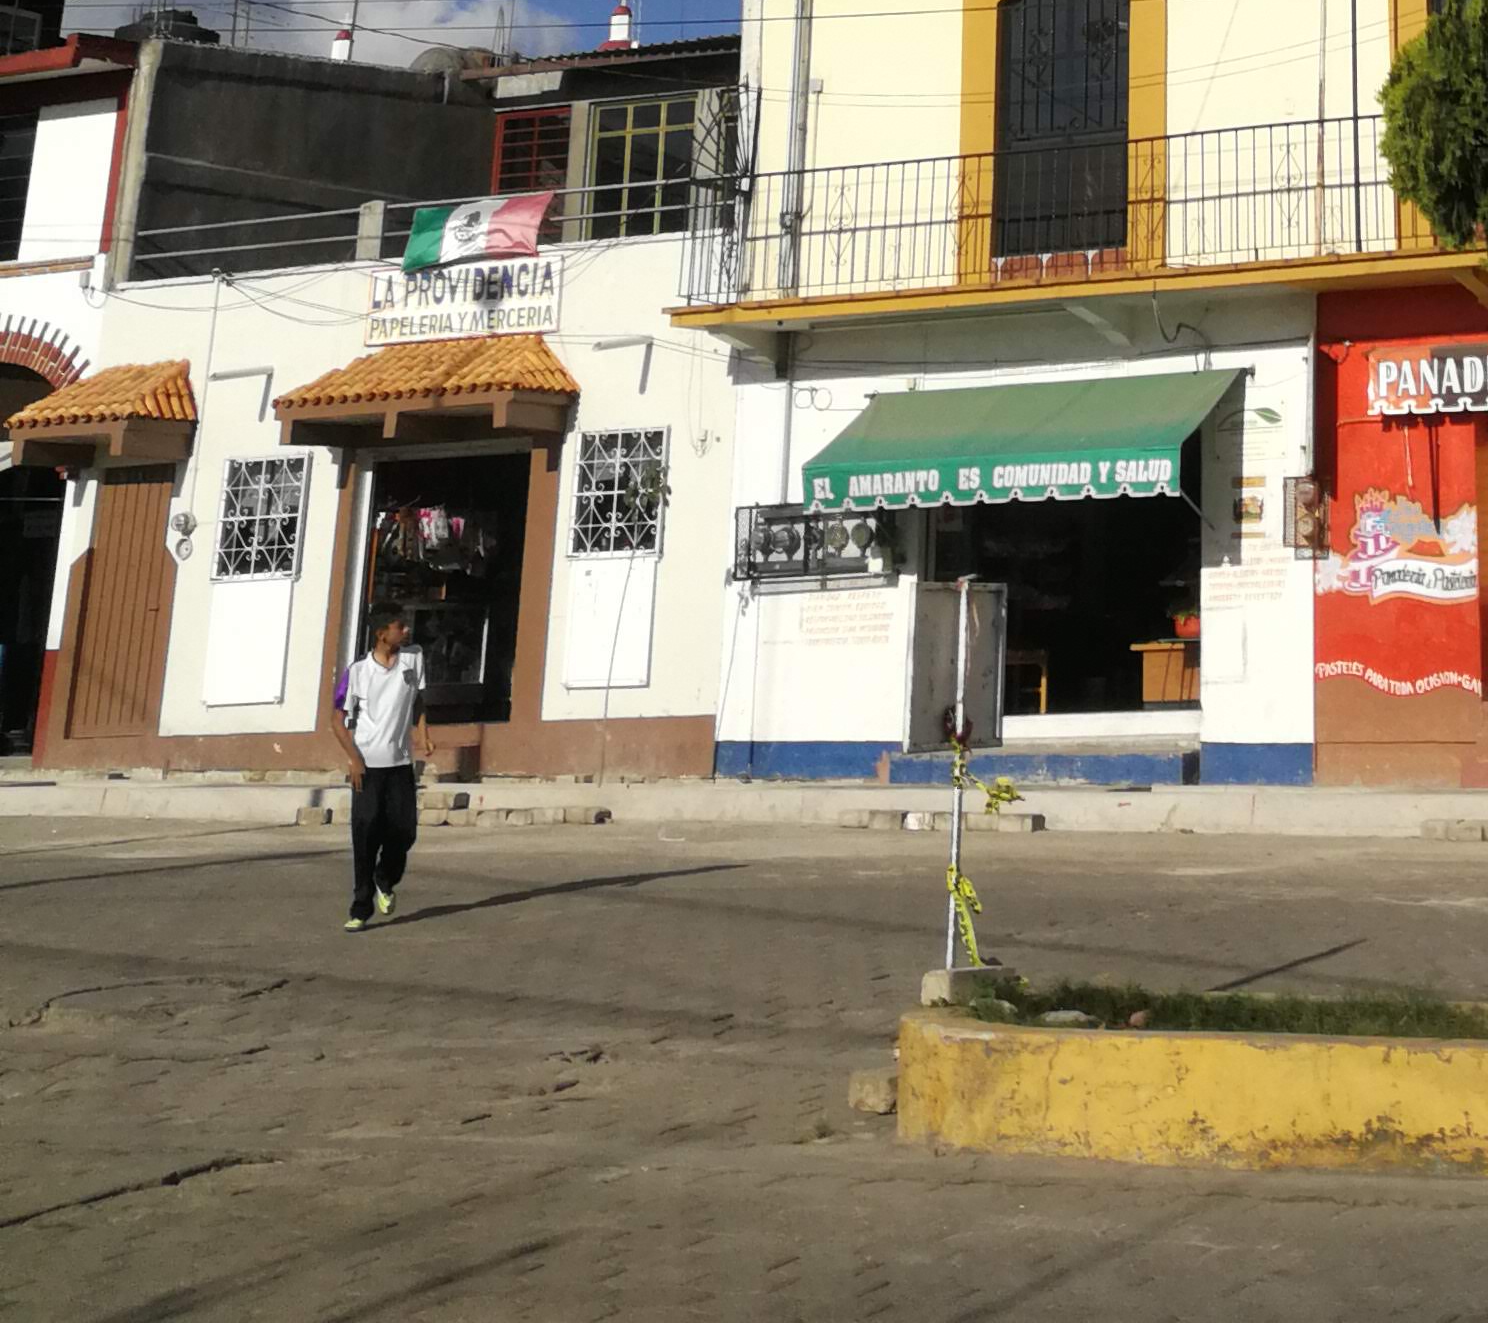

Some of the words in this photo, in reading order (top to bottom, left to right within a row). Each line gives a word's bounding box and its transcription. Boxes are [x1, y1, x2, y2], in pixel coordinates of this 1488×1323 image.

[371, 275, 395, 309] LA
[403, 260, 554, 308] PROVIDENCIA
[369, 313, 453, 340] PAPELERIA
[458, 311, 469, 332] Y
[469, 305, 553, 333] MERCERIA
[812, 477, 835, 500] EL
[848, 470, 940, 497] AMARANTO
[957, 467, 981, 491] ES
[992, 461, 1092, 488] COMUNIDAD
[1098, 460, 1112, 484] Y
[1114, 459, 1173, 483] SALUD
